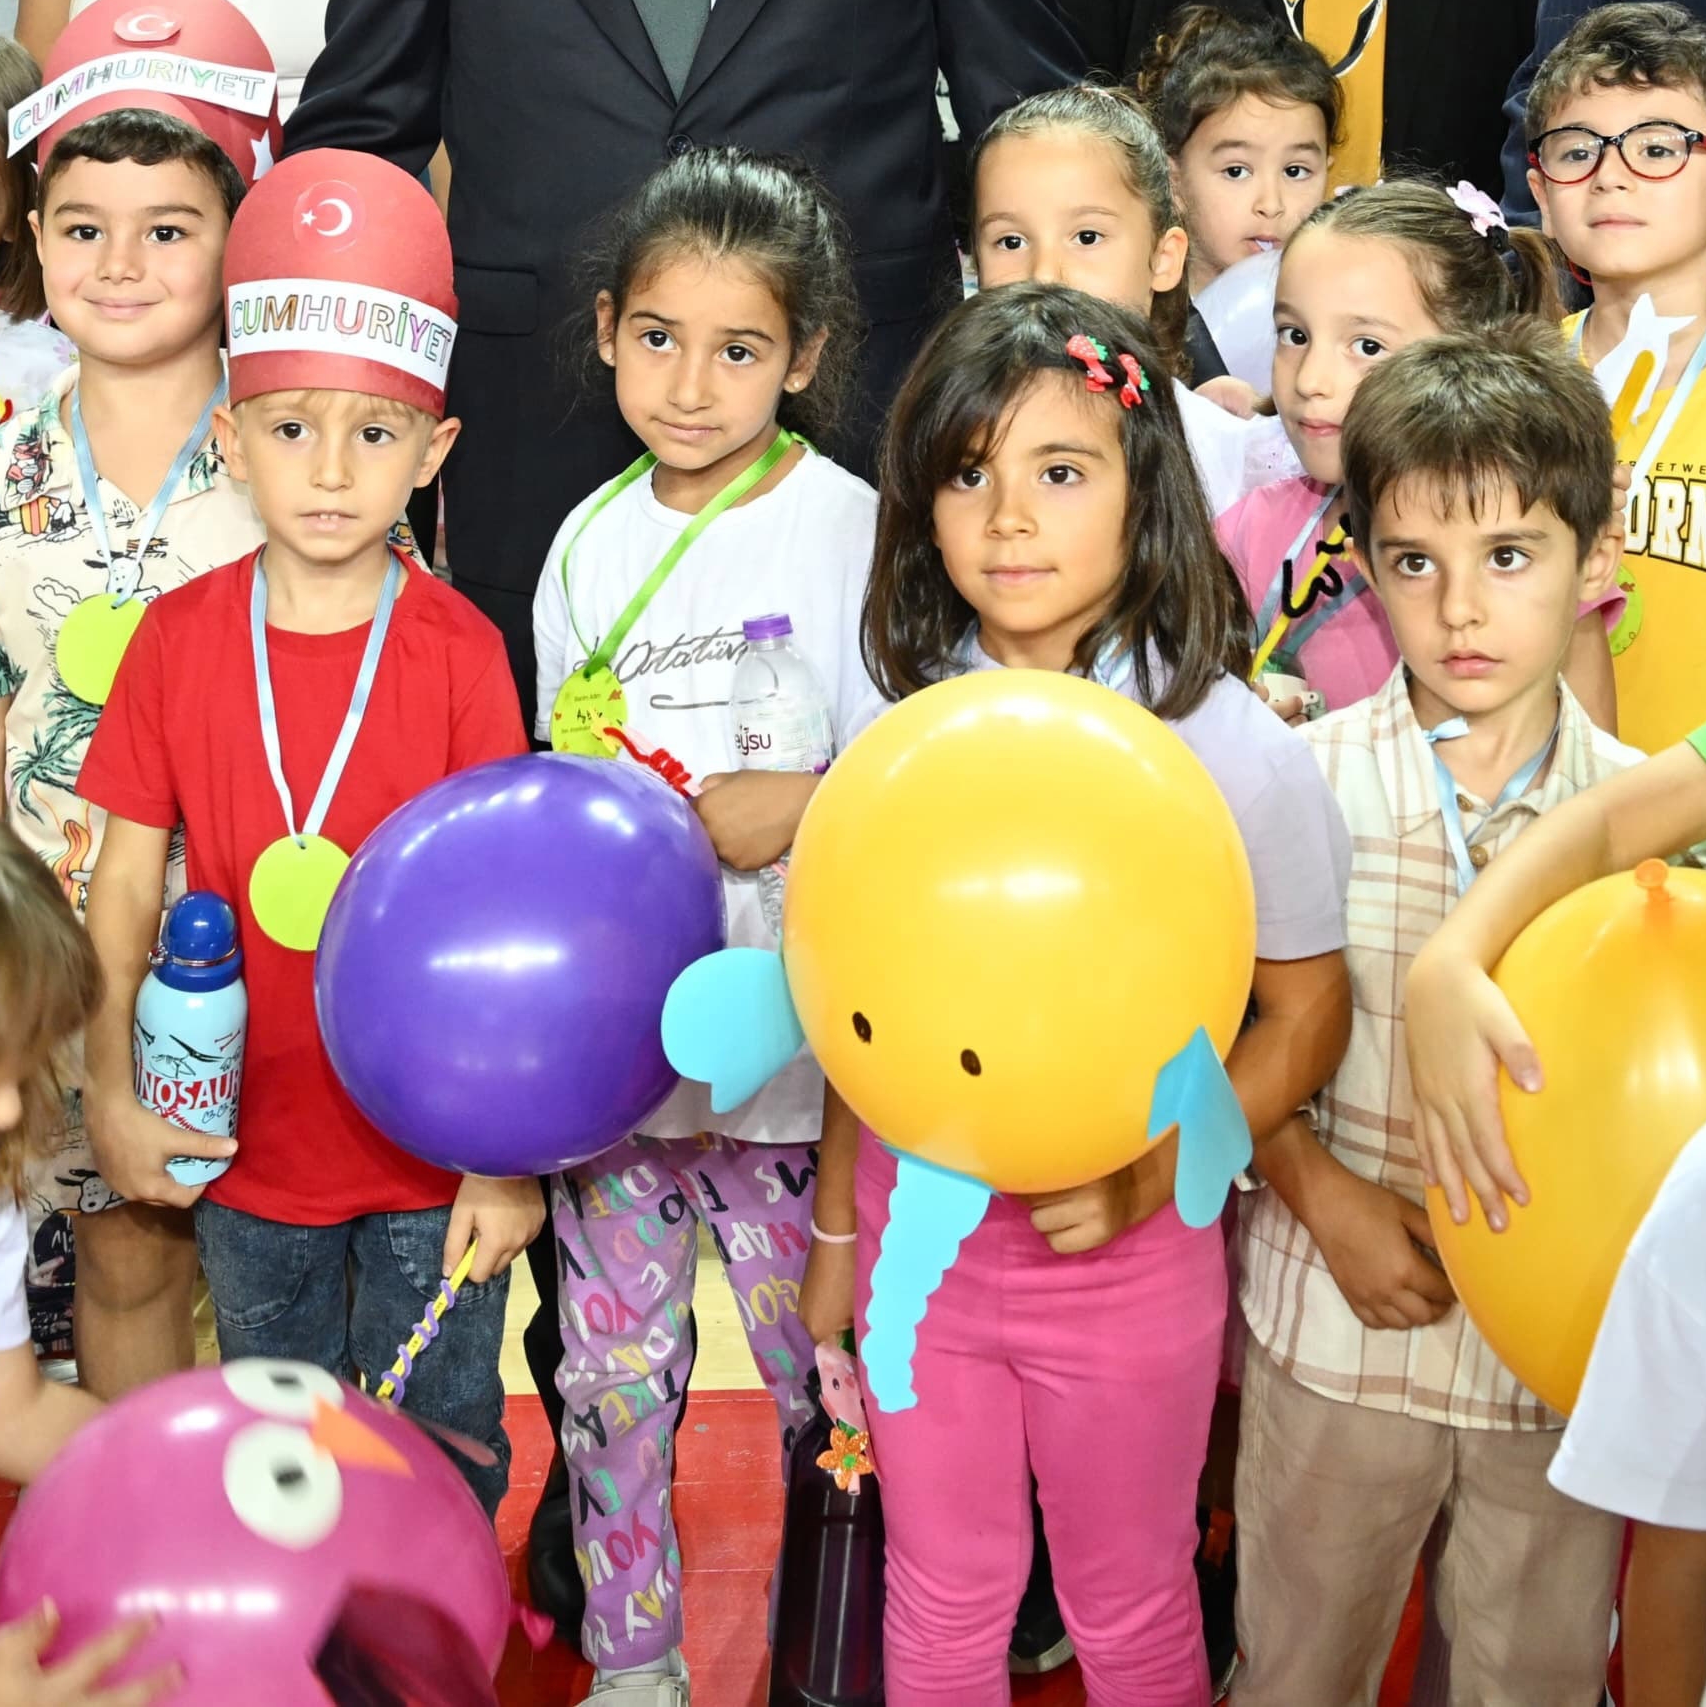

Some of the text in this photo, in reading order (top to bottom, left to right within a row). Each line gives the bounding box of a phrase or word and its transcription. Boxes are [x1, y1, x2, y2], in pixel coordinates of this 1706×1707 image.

[12, 57, 266, 141] CUMHURİYET
[231, 294, 452, 368] CUMHURİYET
[135, 1062, 241, 1110] INOSAUR
